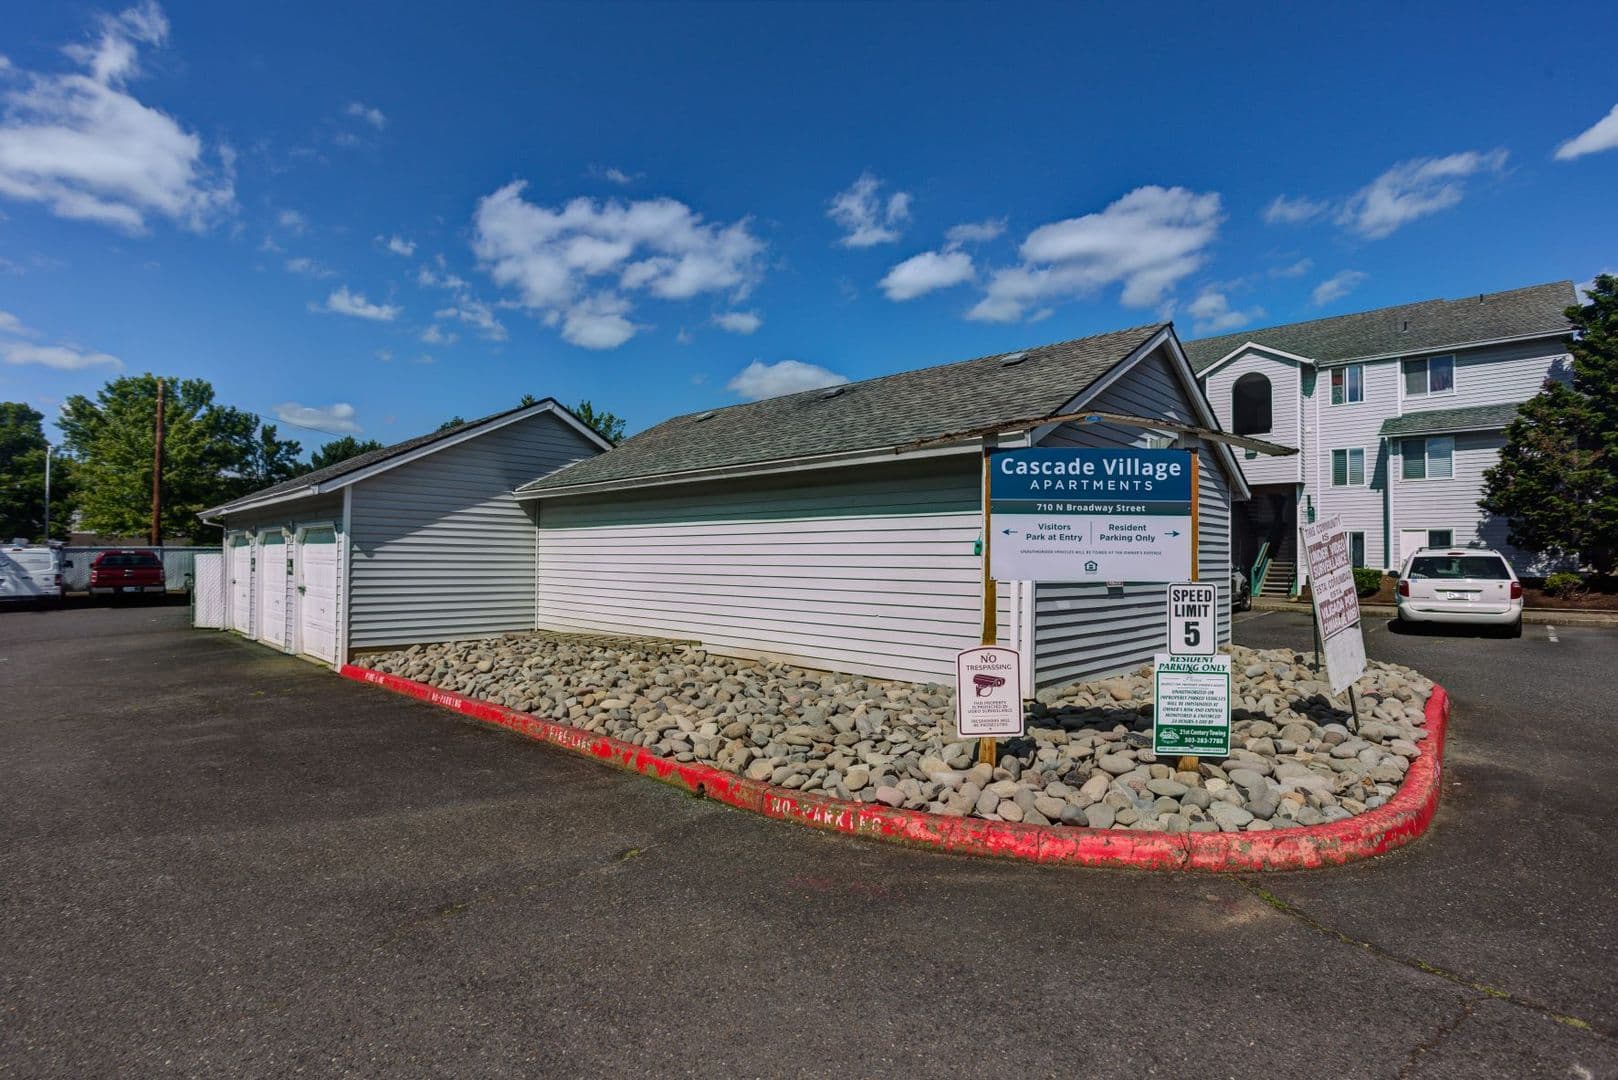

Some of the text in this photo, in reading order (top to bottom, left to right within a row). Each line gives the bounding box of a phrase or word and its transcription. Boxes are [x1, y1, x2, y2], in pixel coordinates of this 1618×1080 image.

[1001, 458, 1181, 480] Cascade Village
[1030, 480, 1153, 491] APARTMENTS
[1036, 503, 1053, 511] 710
[1066, 503, 1114, 513] Broadway
[1116, 504, 1146, 512] Street
[1038, 523, 1071, 531] Visitors
[1108, 523, 1147, 531] Resident
[1026, 533, 1046, 541] Park
[1059, 533, 1083, 542] Entry
[1099, 534, 1156, 543] Parking Only
[1321, 533, 1330, 542] IS
[1172, 589, 1212, 602] SPEED
[1174, 604, 1210, 617] LIMIT
[1184, 621, 1200, 646] 5
[980, 655, 997, 663] NO
[1158, 663, 1228, 672] PARKING ONLY
[1190, 729, 1210, 737] Century
[1210, 729, 1226, 737] Towing
